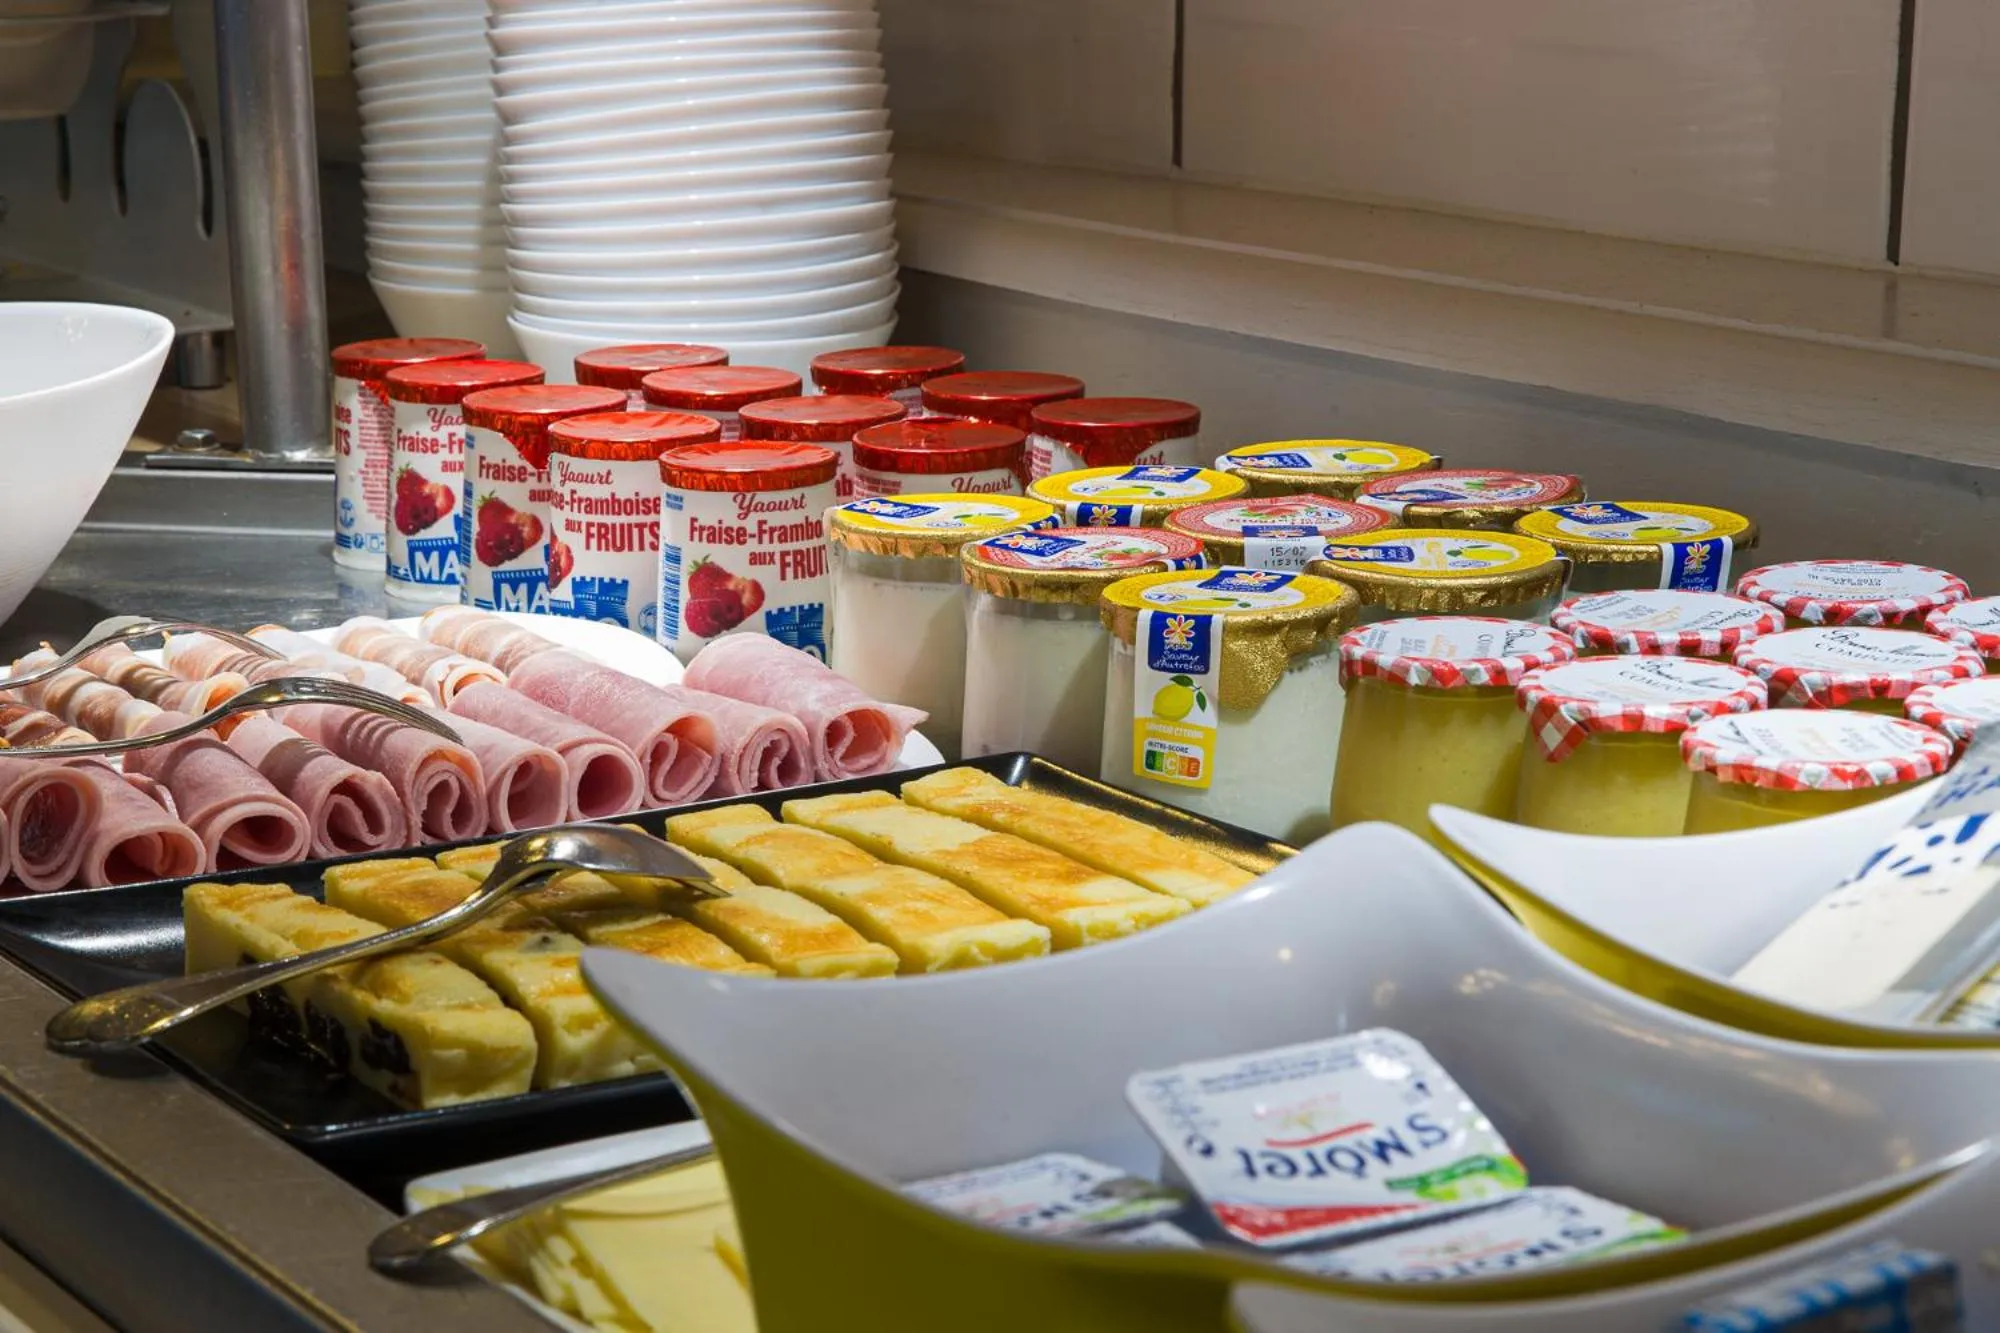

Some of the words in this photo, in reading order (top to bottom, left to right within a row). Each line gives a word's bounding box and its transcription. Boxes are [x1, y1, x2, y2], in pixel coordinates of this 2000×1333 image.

[558, 461, 614, 486] Yaourt
[951, 476, 1013, 493] Yaourt
[733, 493, 808, 520] Yaourt
[565, 517, 582, 533] aux
[585, 522, 660, 552] FRUITS
[689, 515, 824, 545] Fraise-Frambo
[749, 551, 776, 566] aux
